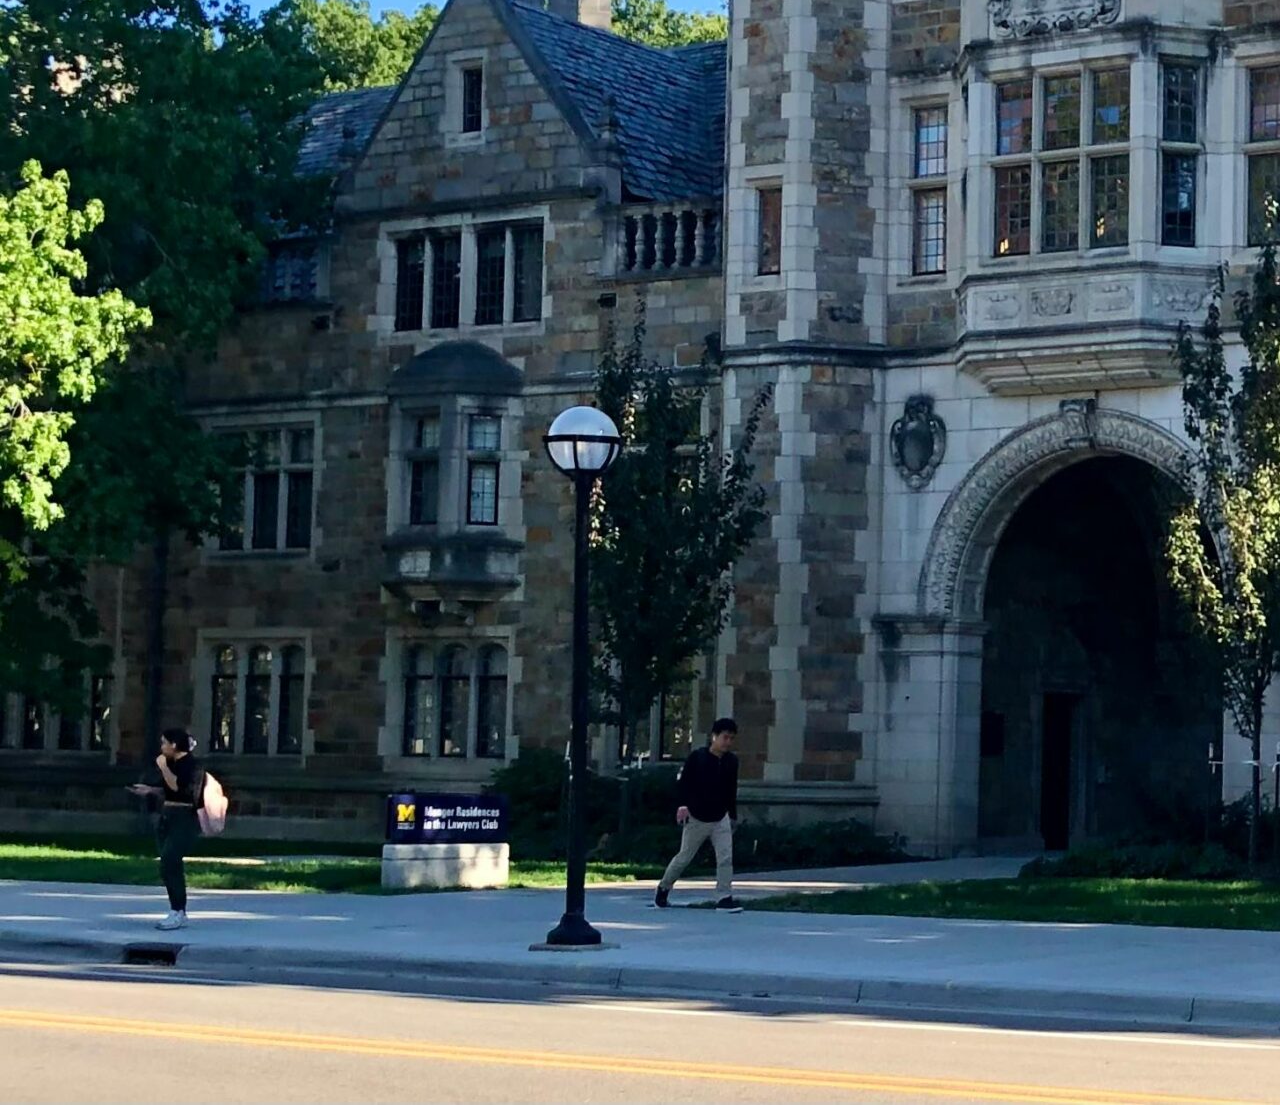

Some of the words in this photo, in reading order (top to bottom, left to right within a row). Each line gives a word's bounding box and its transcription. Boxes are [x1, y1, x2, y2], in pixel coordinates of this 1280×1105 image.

[397, 804, 416, 822] M
[456, 806, 500, 817] Residences
[447, 819, 479, 831] Lawyers
[481, 819, 498, 829] Club
